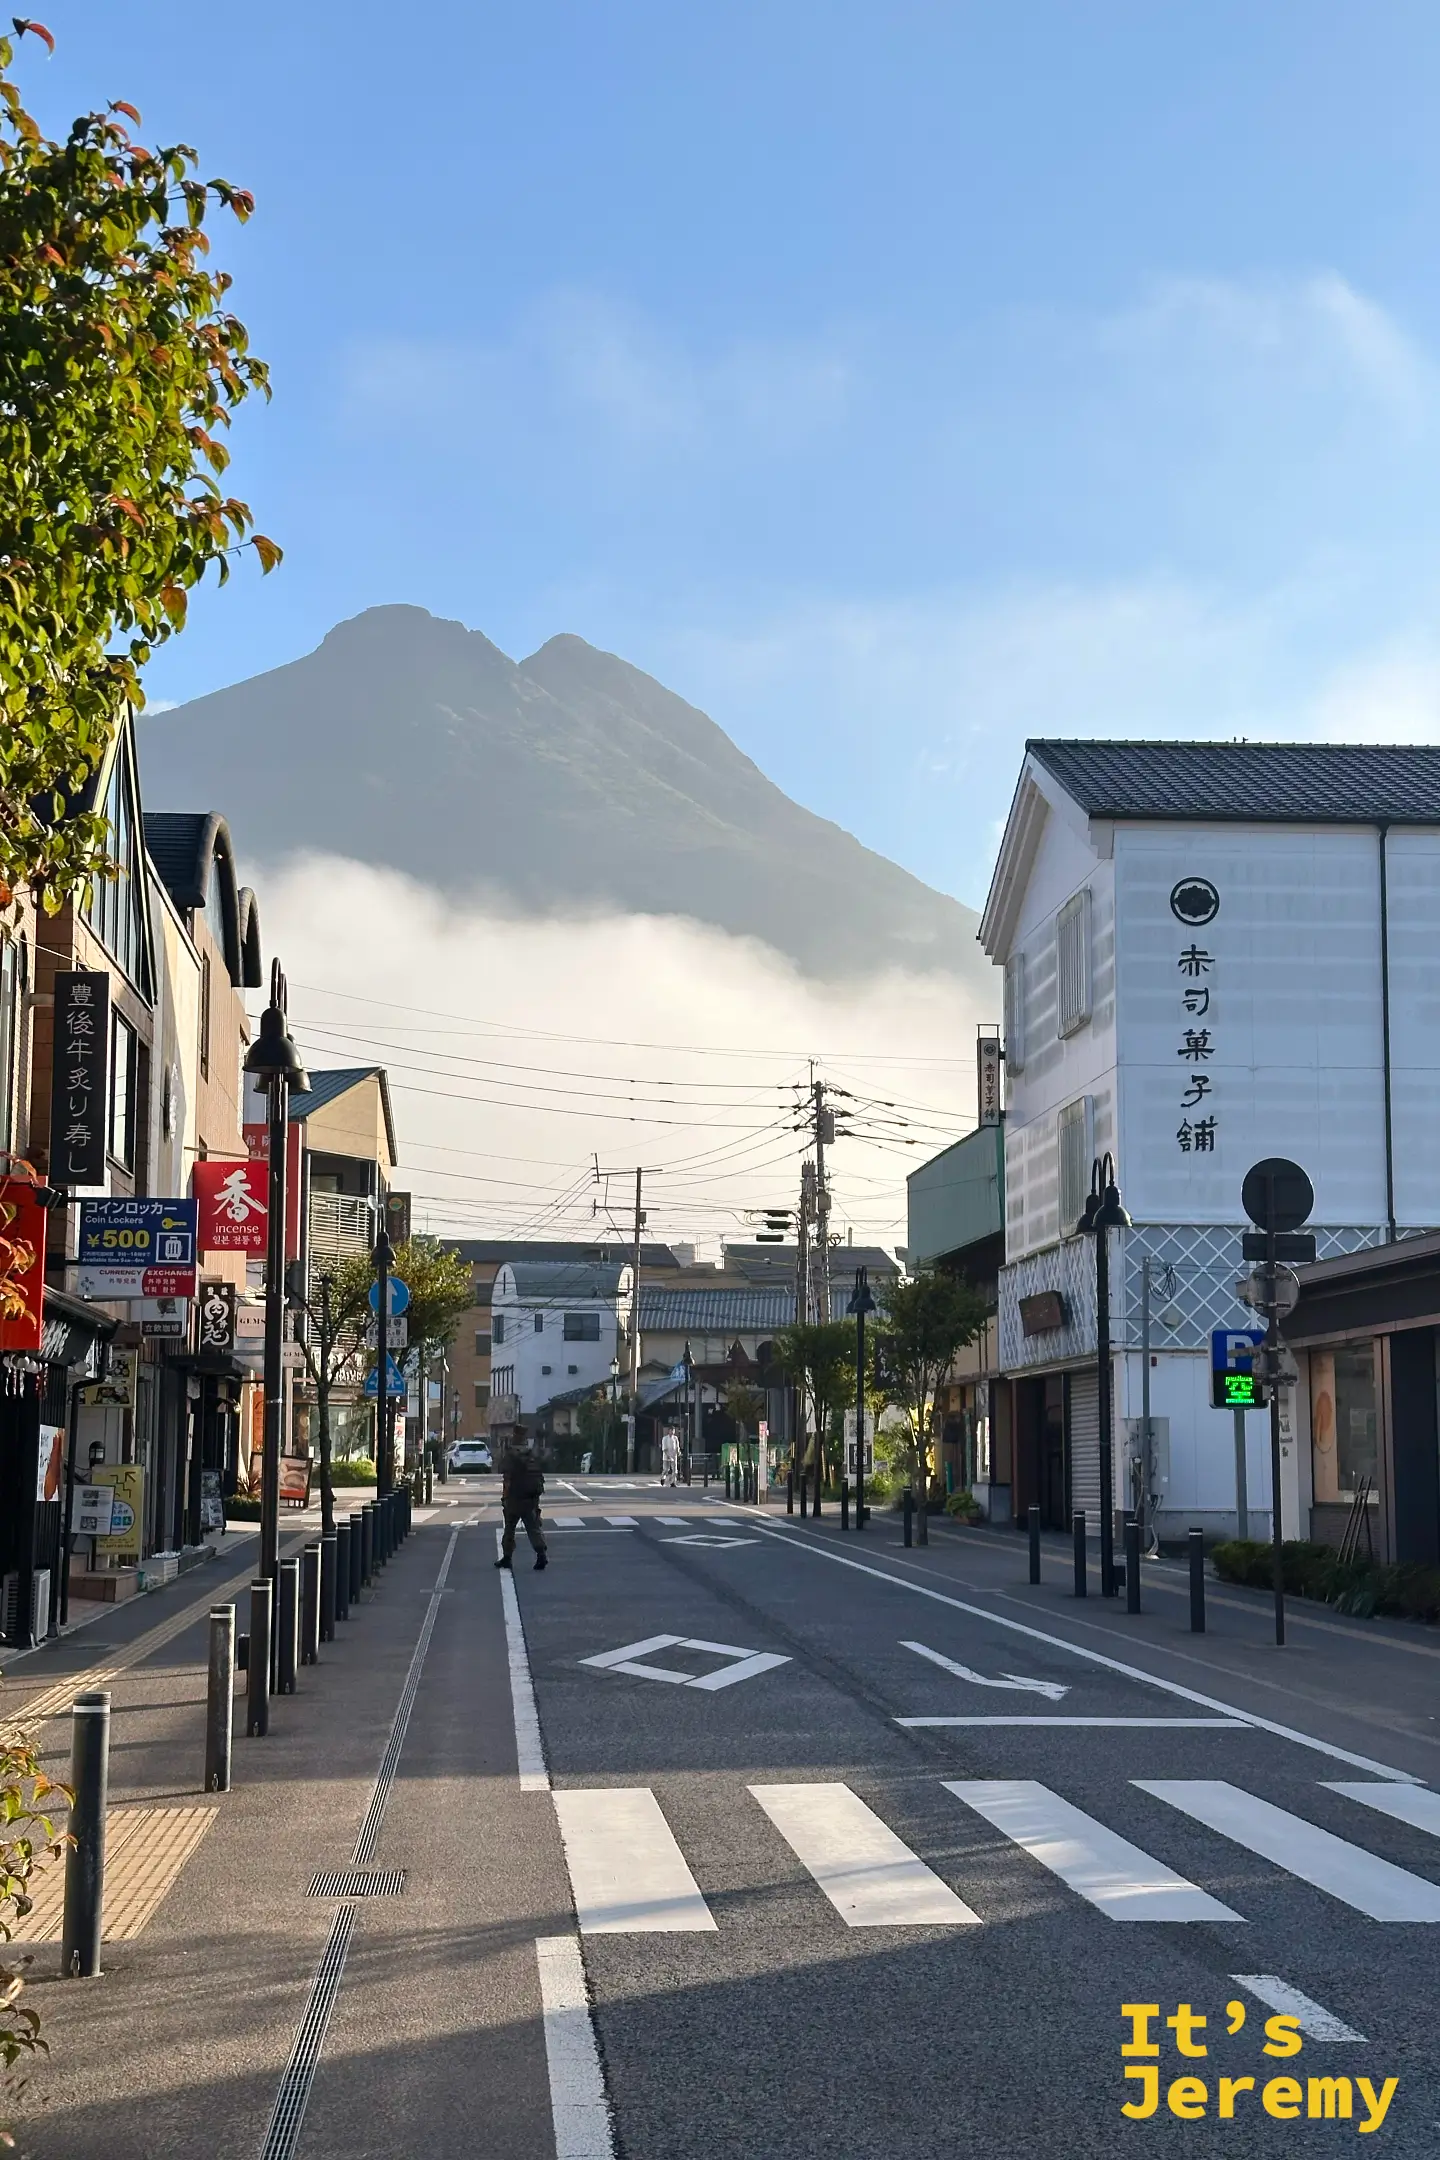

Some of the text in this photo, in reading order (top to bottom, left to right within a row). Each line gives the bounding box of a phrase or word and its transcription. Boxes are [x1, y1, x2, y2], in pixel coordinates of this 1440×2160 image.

[63, 982, 96, 1174] 豊後牛炙り寿し
[211, 1168, 268, 1223] 香
[85, 1202, 178, 1215] コインロッカー
[85, 1215, 144, 1225] Coin Lockers
[215, 1222, 260, 1234] incense
[86, 1229, 151, 1249] ¥500
[147, 1269, 194, 1277] EXCHANGE
[1226, 1334, 1254, 1368] P
